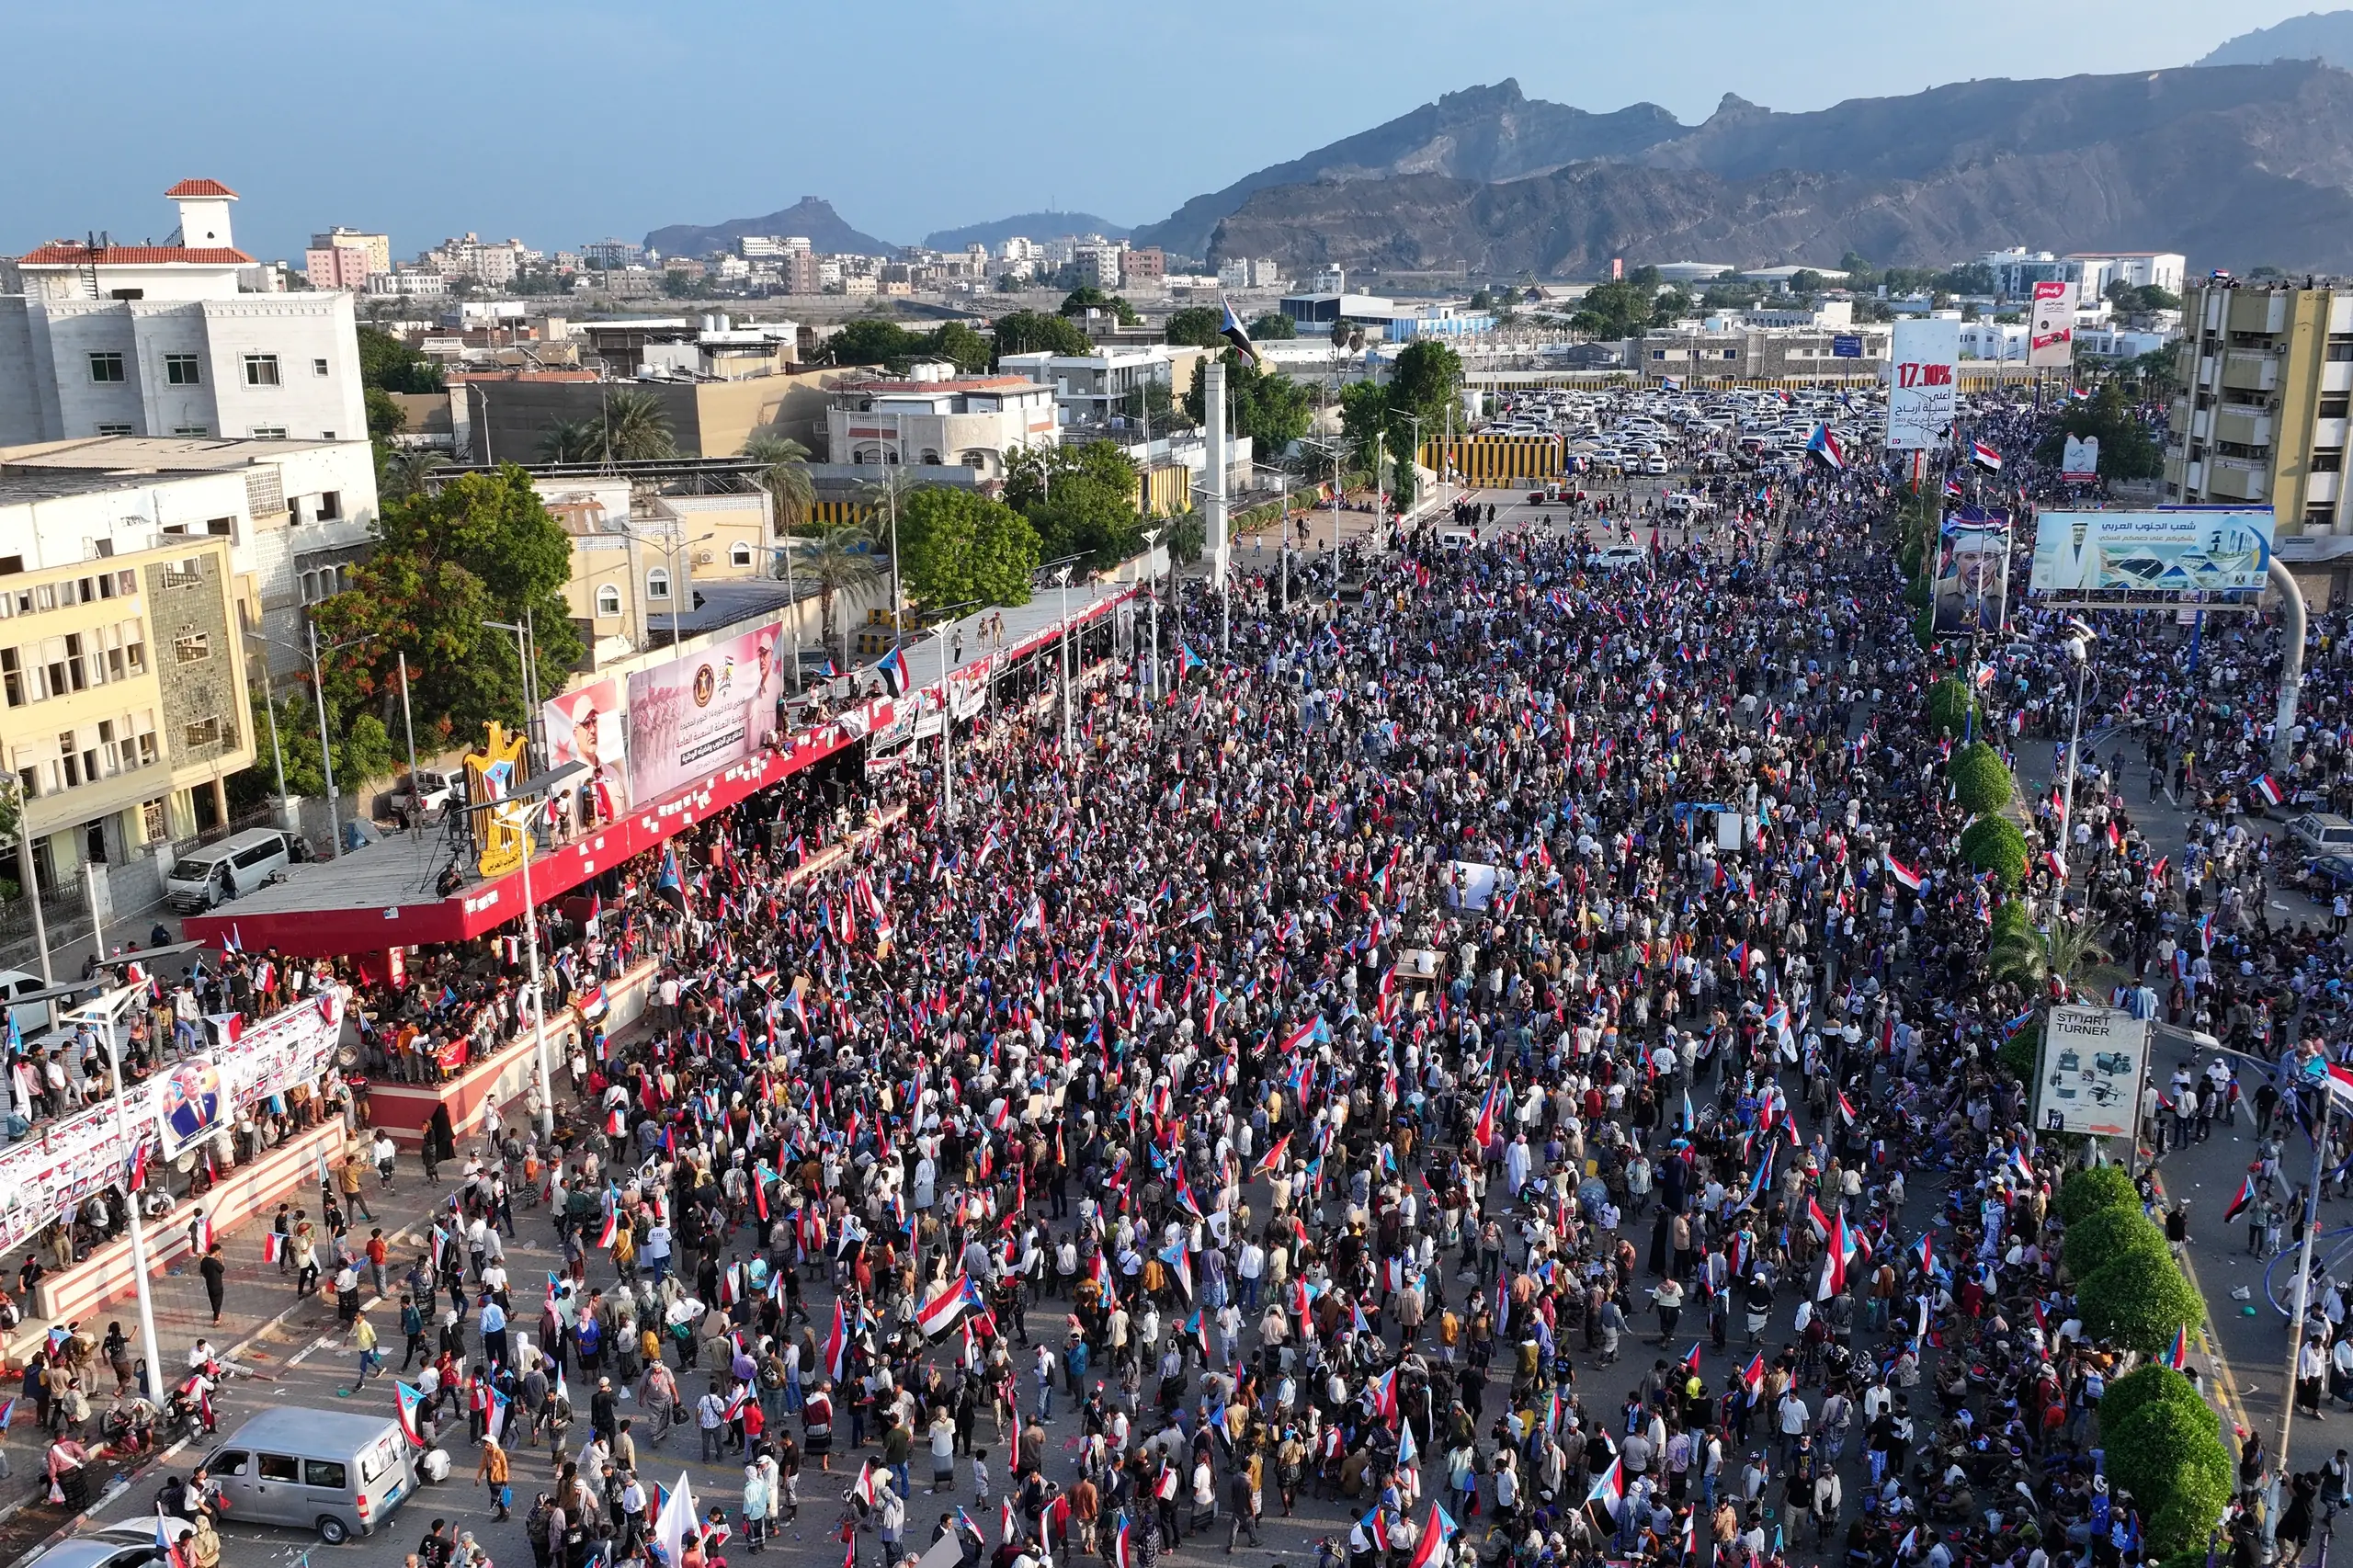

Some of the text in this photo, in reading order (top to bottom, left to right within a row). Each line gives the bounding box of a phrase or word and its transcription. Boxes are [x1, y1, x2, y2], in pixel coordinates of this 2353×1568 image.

[1897, 363, 1952, 388] 17.10%
[2101, 521, 2197, 532] شعب الجنوب العربي
[2056, 1022, 2109, 1037] TURNER
